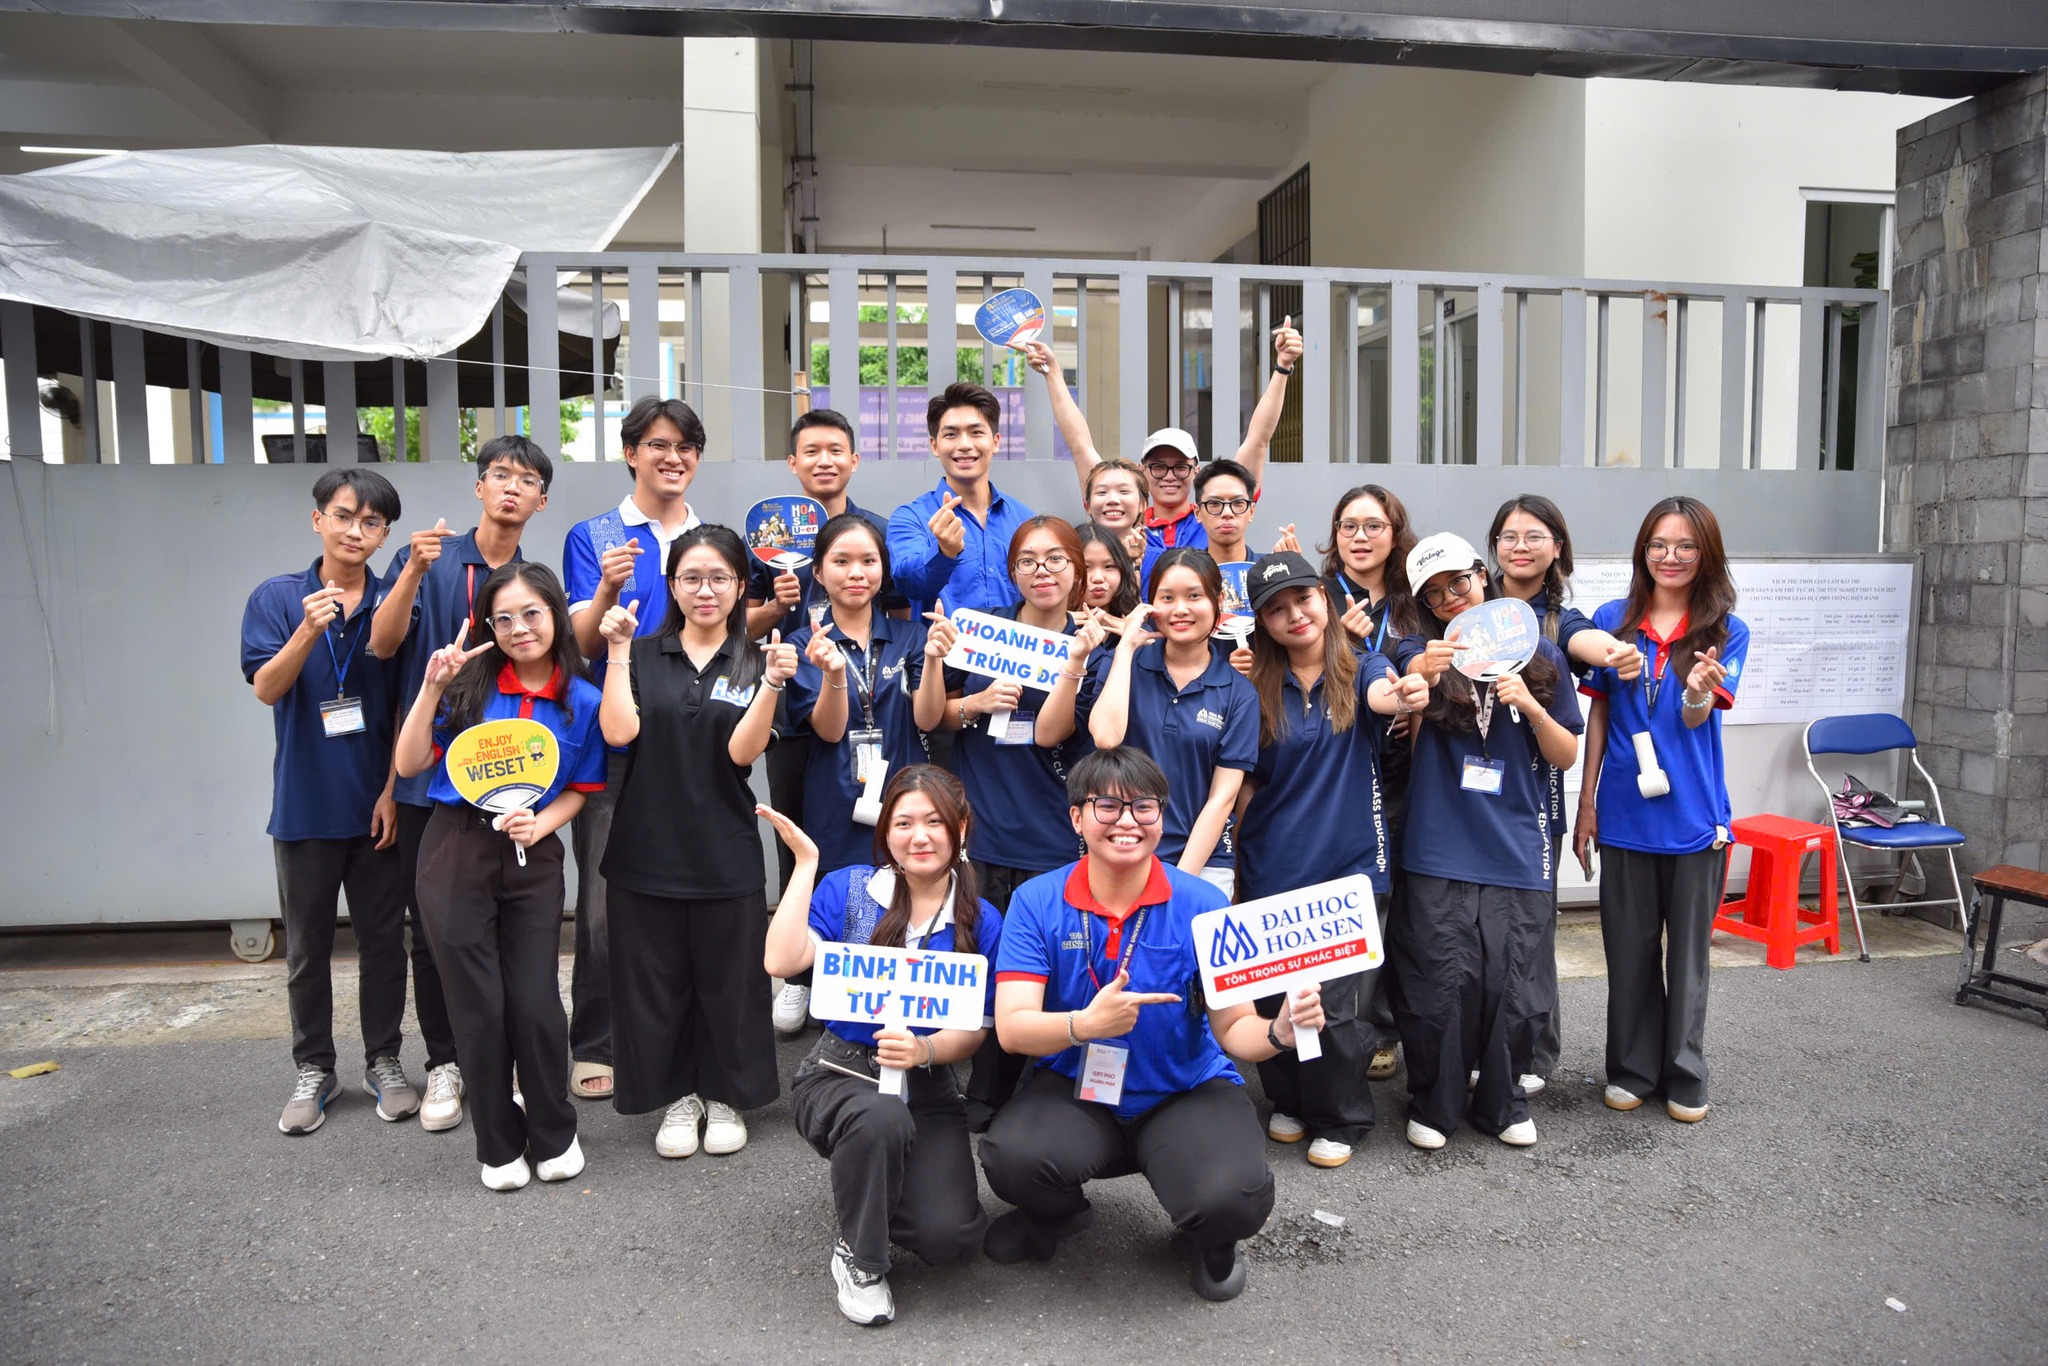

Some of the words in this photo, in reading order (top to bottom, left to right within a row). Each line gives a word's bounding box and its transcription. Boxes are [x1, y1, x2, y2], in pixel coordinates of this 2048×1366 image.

[792, 503, 815, 517] HOA
[792, 513, 816, 526] SEN
[793, 526, 817, 534] U-er
[954, 616, 1038, 652] KHOANH
[1042, 639, 1070, 661] ĐÂ
[963, 647, 1032, 679] TRÚNG
[475, 744, 521, 762] ENGLISH
[478, 734, 513, 750] ENJOY
[465, 756, 526, 782] WESET
[1373, 813, 1388, 873] EDUCATION
[1260, 906, 1303, 932] ĐẠI
[1305, 891, 1360, 921] HỌC
[1265, 926, 1318, 954] HOA
[1320, 914, 1364, 940] SEN
[823, 947, 897, 981] BÌNH
[906, 955, 980, 988] TĨNH
[1223, 973, 1248, 987] TÔN
[1249, 962, 1286, 982] TRỌNG
[1287, 957, 1303, 972] SỰ
[1303, 948, 1333, 966] KHÁC
[1334, 942, 1358, 958] BIỆT
[847, 988, 891, 1020] TỰ
[899, 994, 950, 1020] TIN
